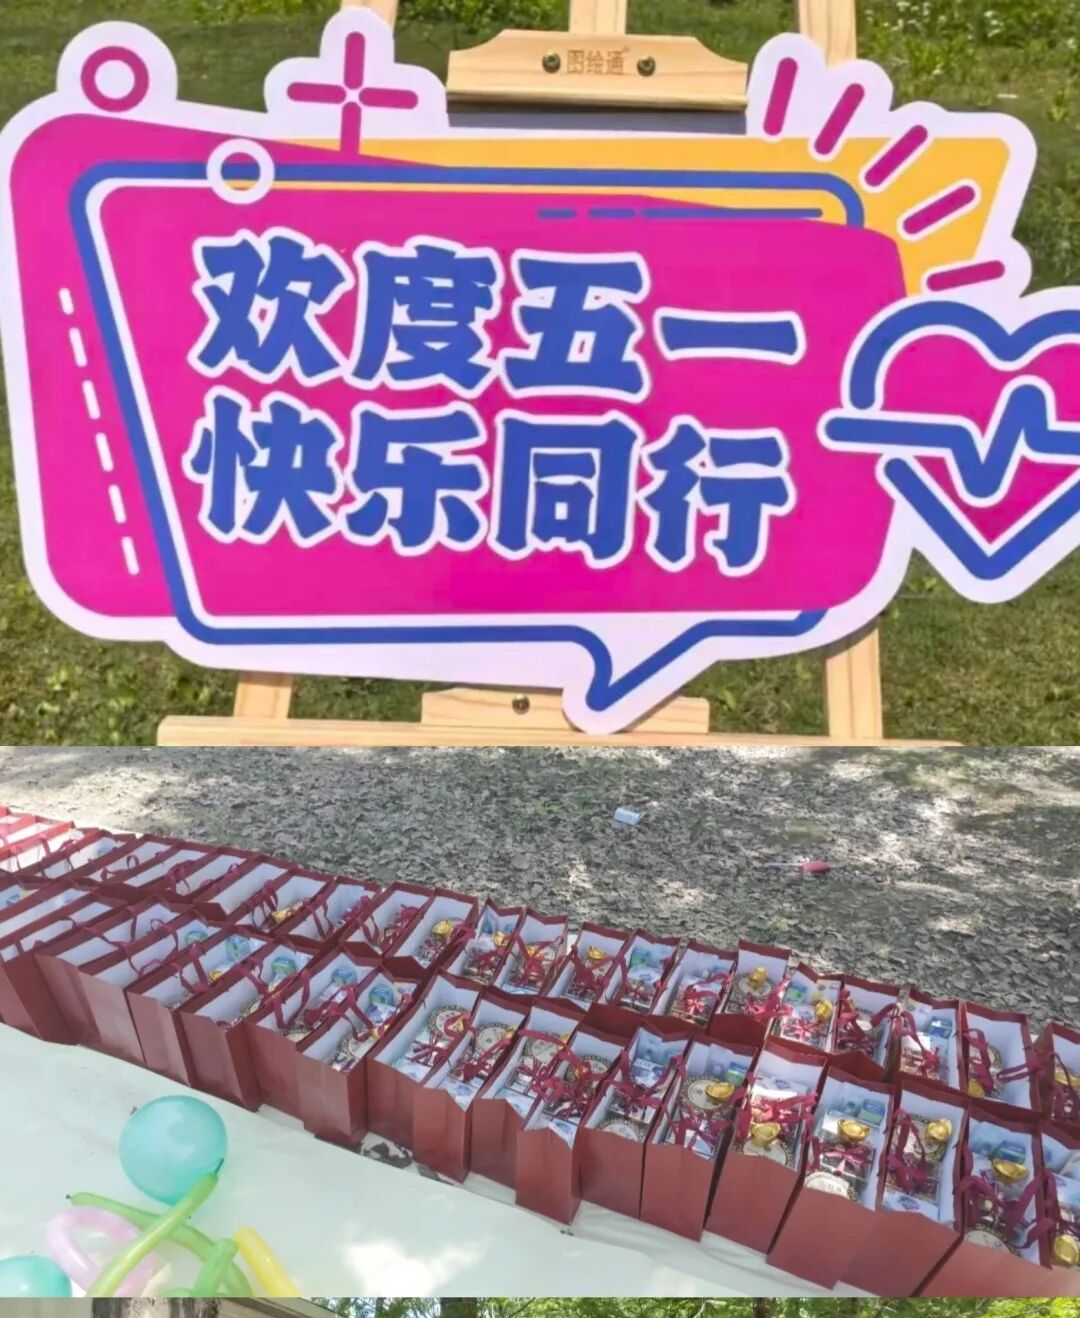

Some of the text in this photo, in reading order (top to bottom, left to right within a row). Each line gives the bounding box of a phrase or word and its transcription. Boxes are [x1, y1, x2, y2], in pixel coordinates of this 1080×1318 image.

[566, 49, 624, 75] 图绘通
[192, 230, 804, 400] 欢度五一
[187, 391, 793, 572] 快乐同行
